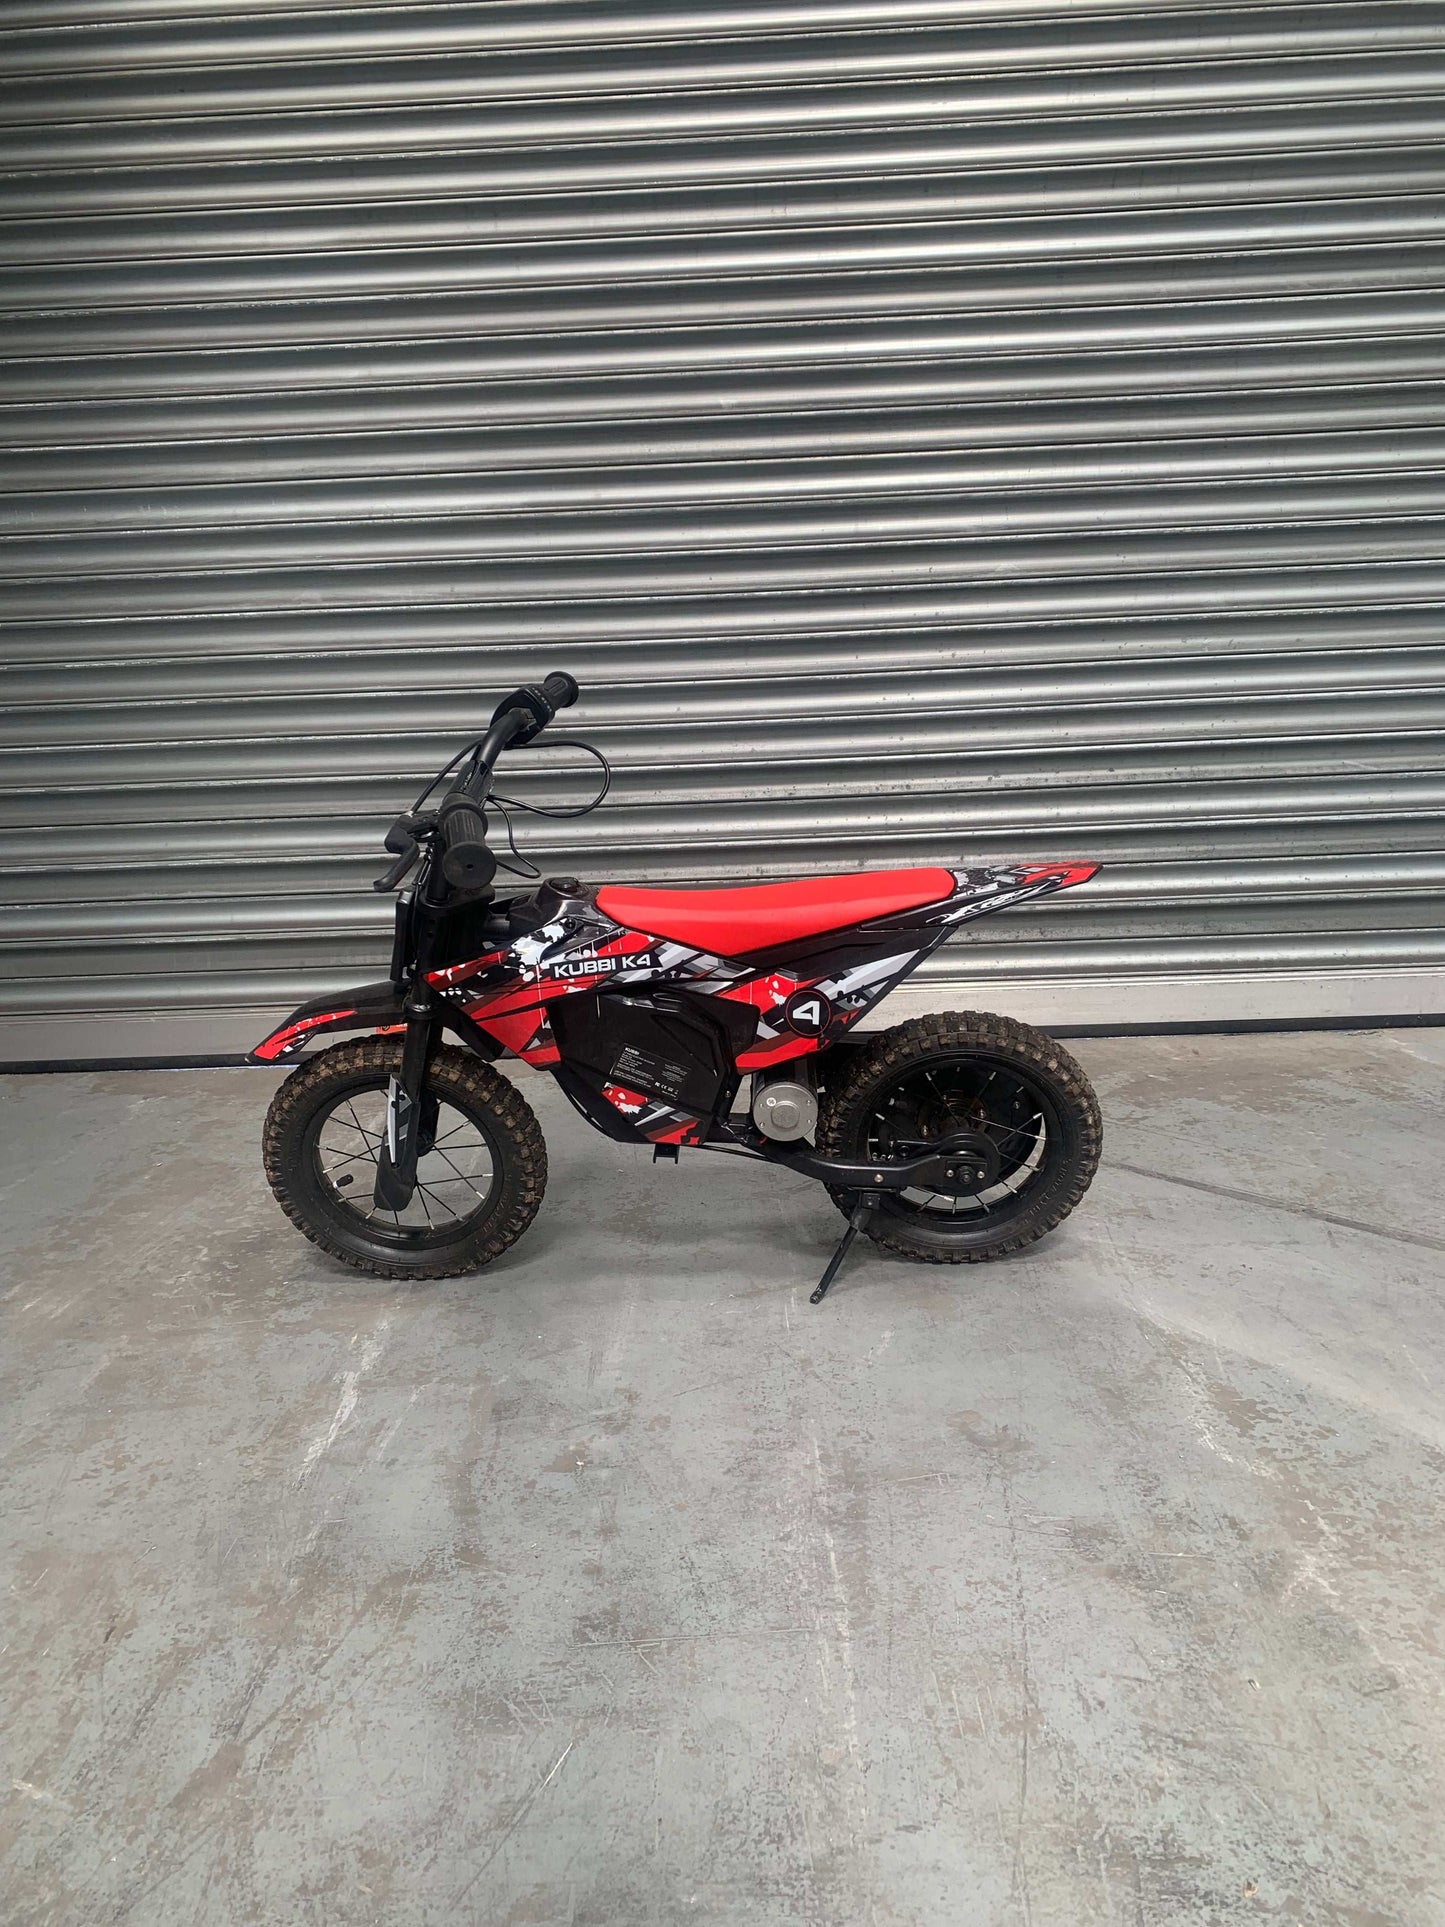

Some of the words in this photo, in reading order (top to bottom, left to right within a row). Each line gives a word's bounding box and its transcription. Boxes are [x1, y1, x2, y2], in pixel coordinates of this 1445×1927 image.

[554, 957, 617, 978] KUBBI
[621, 953, 651, 969] K4
[792, 1000, 820, 1026] 4
